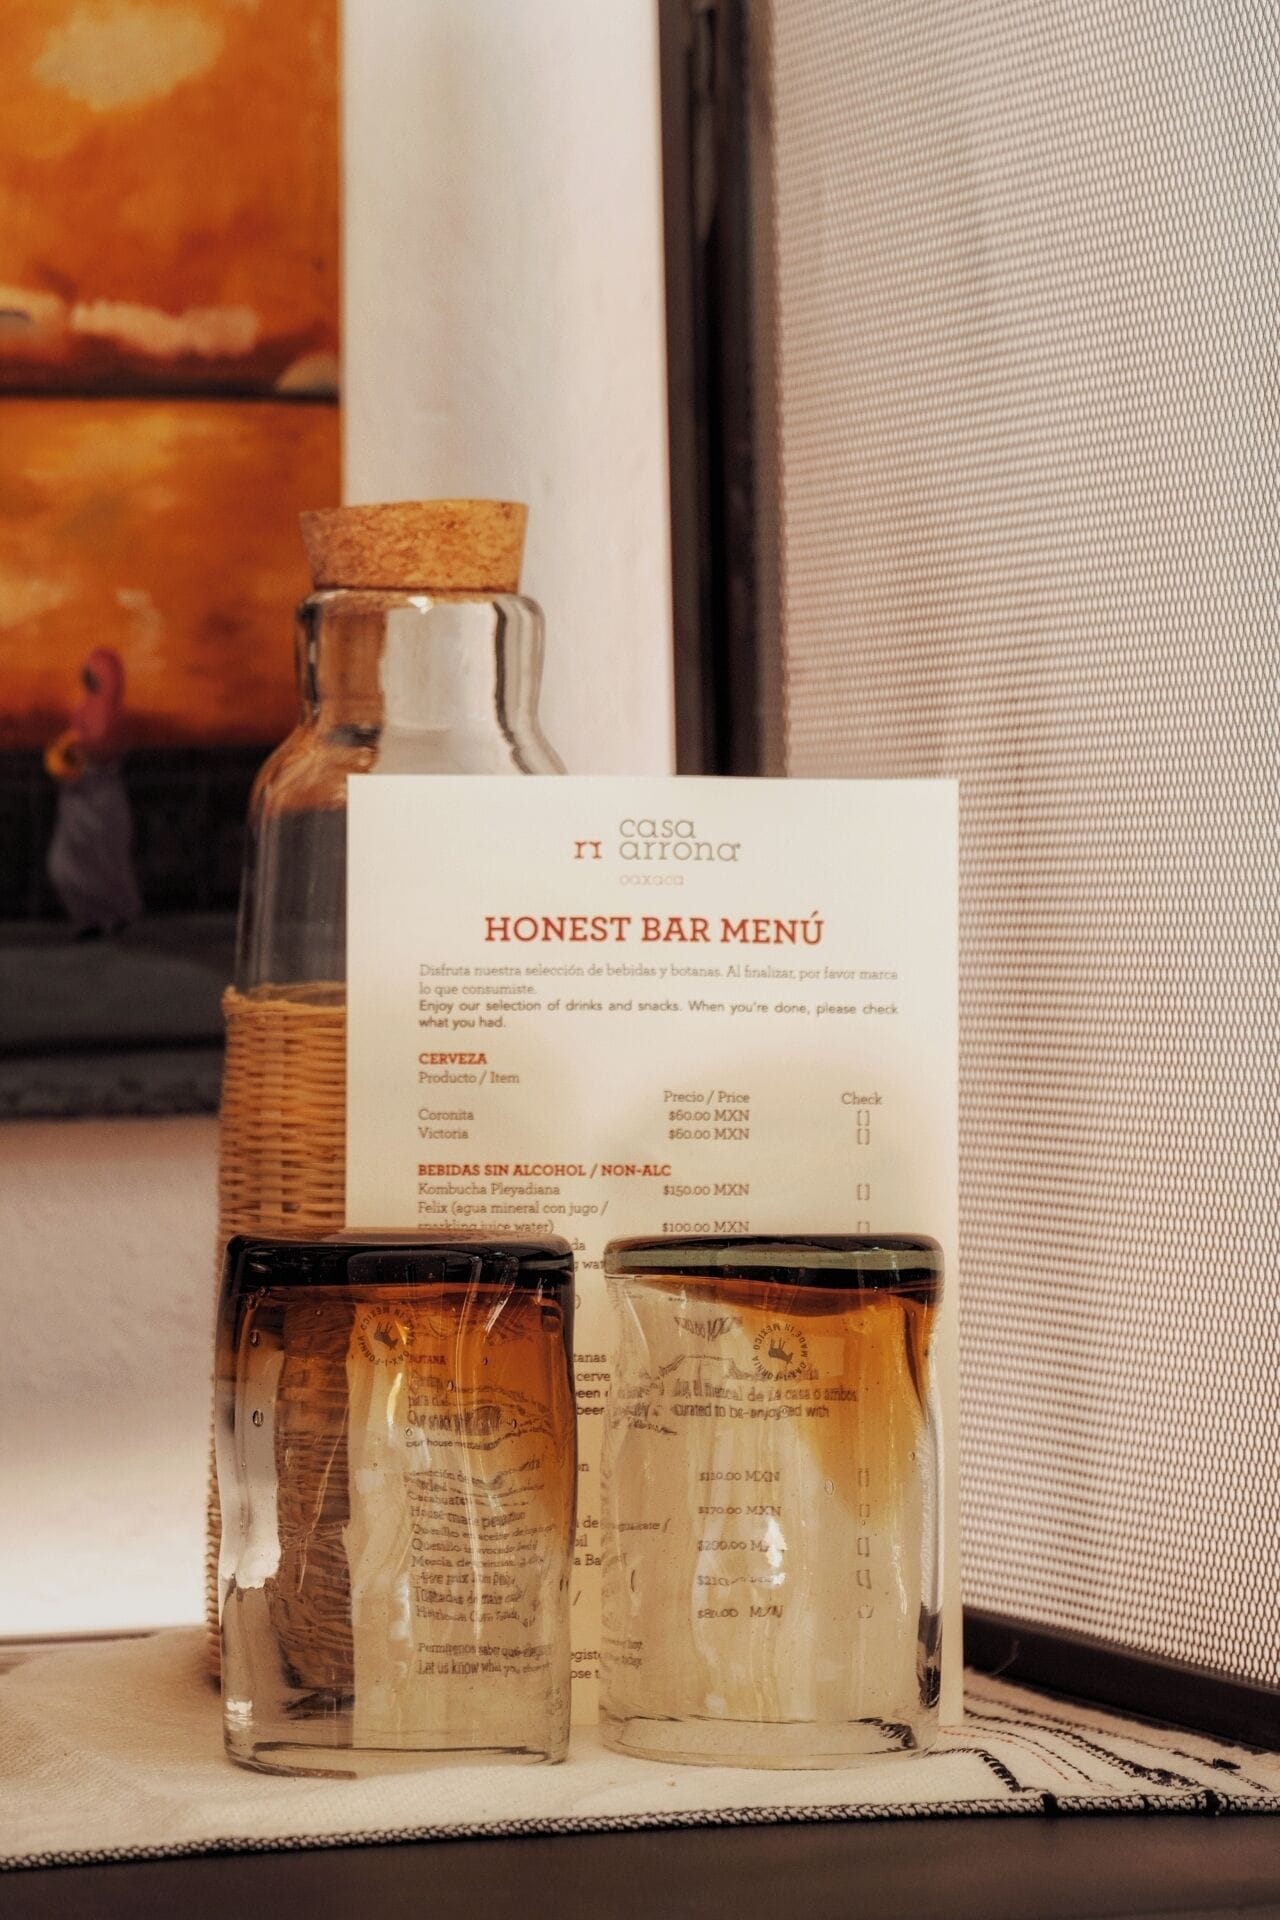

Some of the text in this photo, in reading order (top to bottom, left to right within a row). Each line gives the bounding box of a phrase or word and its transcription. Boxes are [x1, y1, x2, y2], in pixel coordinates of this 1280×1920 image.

[619, 818, 697, 839] casa
[618, 840, 742, 862] arrona
[619, 874, 685, 886] oaxaca
[485, 910, 825, 945] HONEST BAR MENÚ
[419, 963, 899, 983] Disfruta nuestra selección de bebidas y botanas. Al finalizar, por favor marca
[419, 982, 538, 998] lo que consumiste.
[419, 999, 899, 1017] Enjoy our selection of drinks and snacks. When you're done, please check
[419, 1017, 507, 1031] what you had.
[418, 1053, 488, 1066] CERVEZA
[418, 1071, 477, 1085] Producto
[490, 1071, 520, 1085] Item
[664, 1089, 704, 1104] Precio
[718, 1090, 750, 1105] Price
[840, 1091, 883, 1106] Check
[418, 1108, 475, 1122] Coronita
[668, 1109, 750, 1123] $60.00 MXN
[418, 1126, 469, 1140] Victoria
[668, 1127, 750, 1141] $60.00 MXN
[418, 1164, 481, 1177] BEBIDAS
[484, 1164, 510, 1177] SIN
[513, 1164, 587, 1177] ALCOHOL
[601, 1164, 672, 1177] NON-ALC
[418, 1182, 561, 1199] Kombucha Pleyadiana
[663, 1184, 750, 1198] $150.00 MXN
[418, 1201, 448, 1214] Felix
[450, 1200, 487, 1216] (agua
[490, 1200, 540, 1214] mineral
[542, 1203, 566, 1214] con
[569, 1201, 599, 1217] jugo
[514, 1219, 555, 1235] water)
[662, 1221, 750, 1234] $100.00 MXN
[583, 1515, 599, 1529] de
